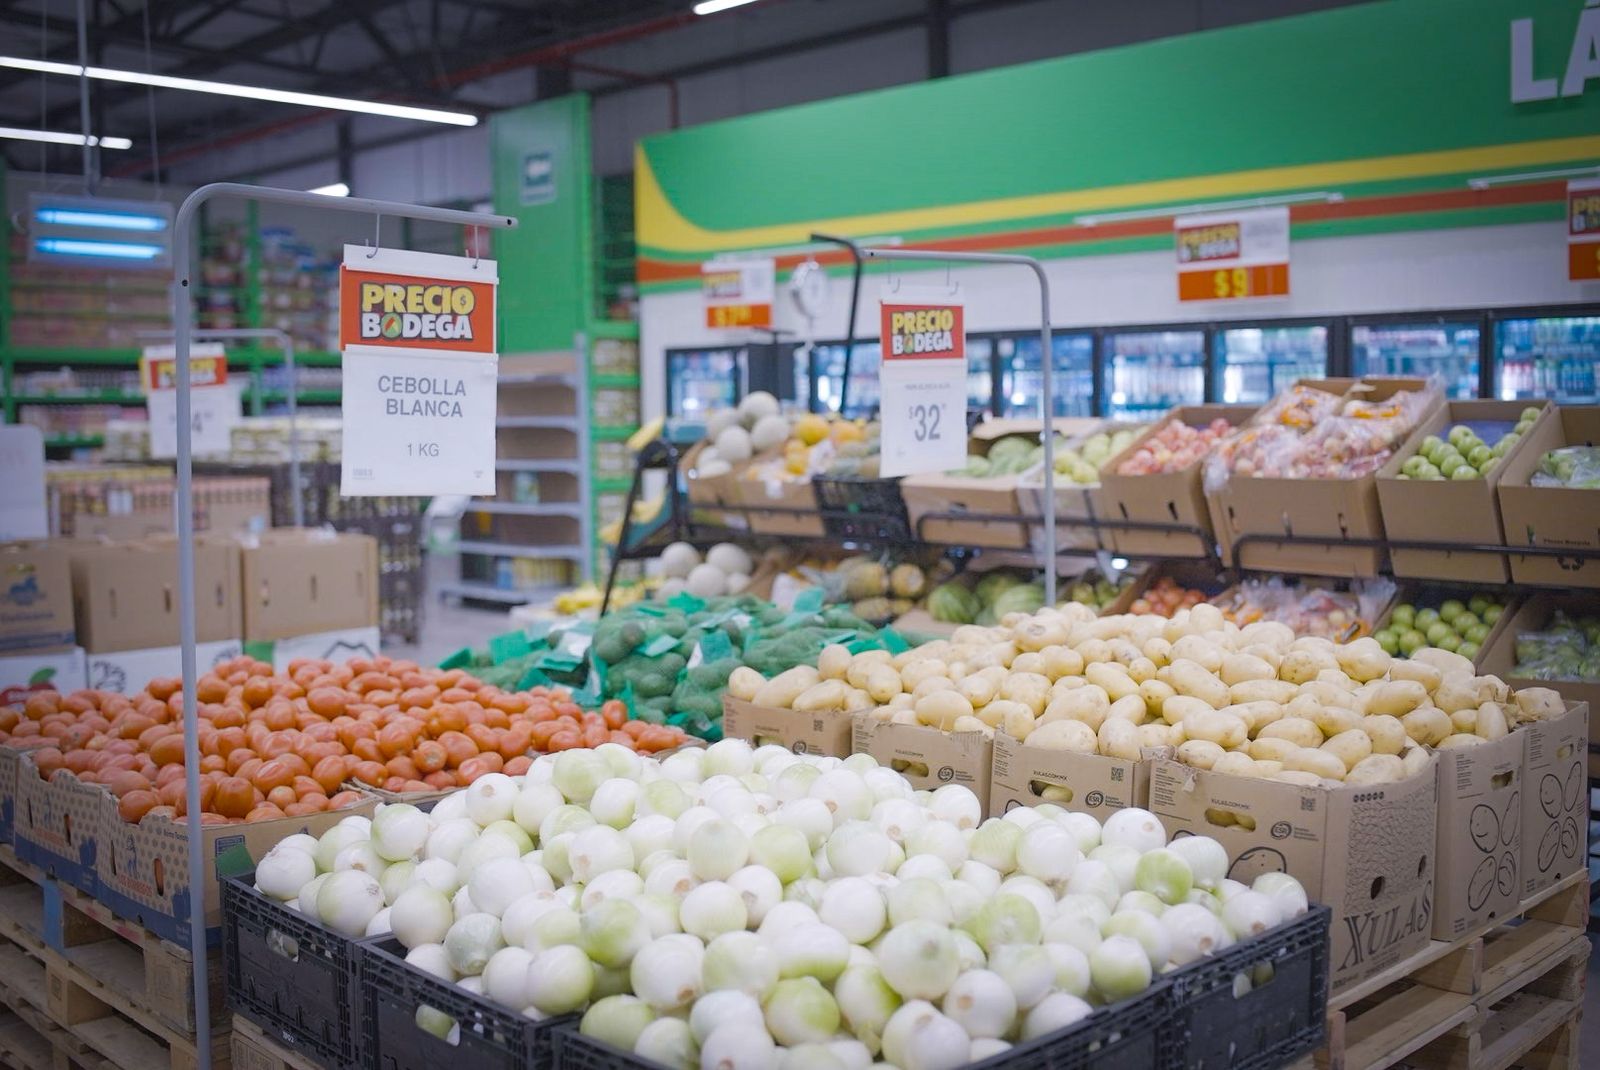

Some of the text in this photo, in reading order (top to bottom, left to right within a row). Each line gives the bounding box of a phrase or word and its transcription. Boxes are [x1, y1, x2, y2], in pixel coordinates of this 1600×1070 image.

[361, 283, 475, 315] PRECIO
[361, 312, 473, 340] BODEGA
[891, 309, 954, 334] PRECIO
[891, 331, 954, 356] BODEGA
[377, 375, 466, 396] CEBOLLA
[385, 398, 463, 418] BLANCA
[407, 443, 440, 457] 1 KG
[1337, 880, 1433, 972] XULAS
